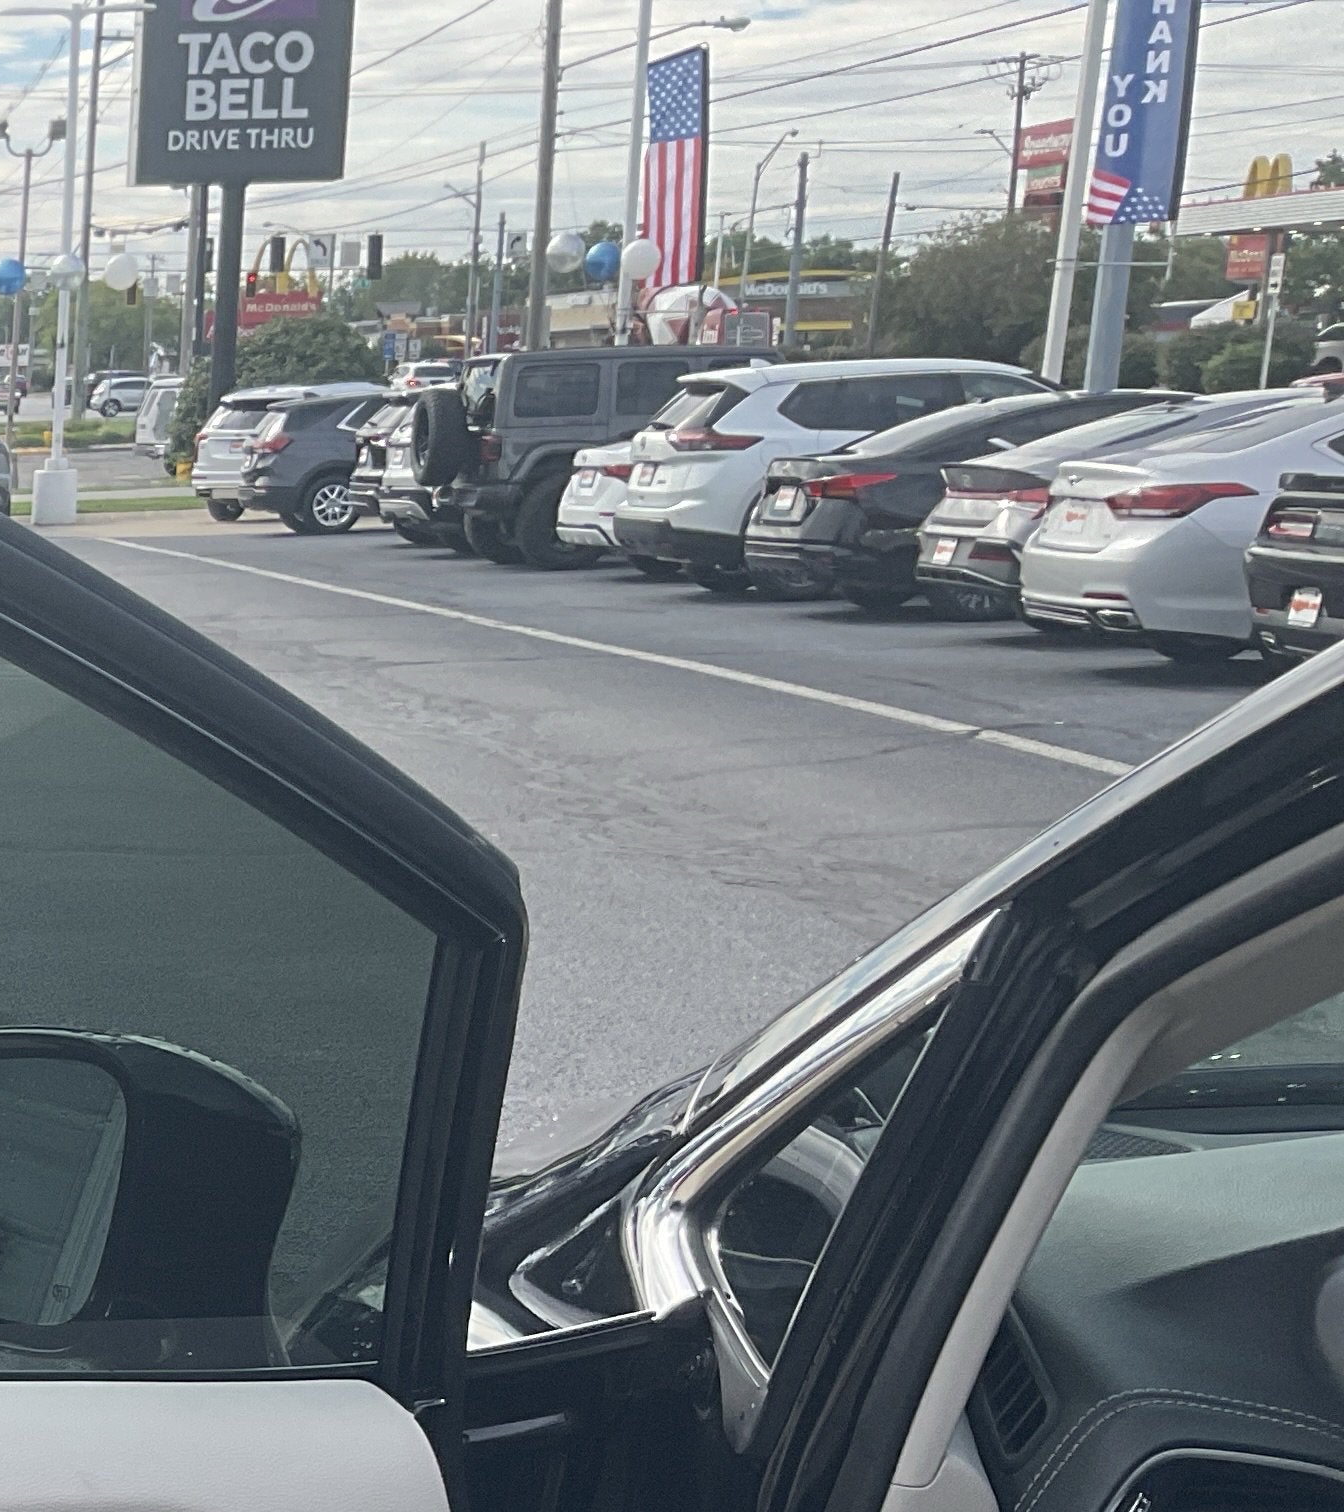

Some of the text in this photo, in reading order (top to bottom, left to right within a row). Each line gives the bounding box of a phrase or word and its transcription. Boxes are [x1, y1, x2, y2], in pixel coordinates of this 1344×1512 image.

[177, 30, 315, 75] TACO
[185, 77, 309, 121] BELL
[167, 126, 315, 151] DRIVE THRU
[245, 302, 317, 313] McDonald's
